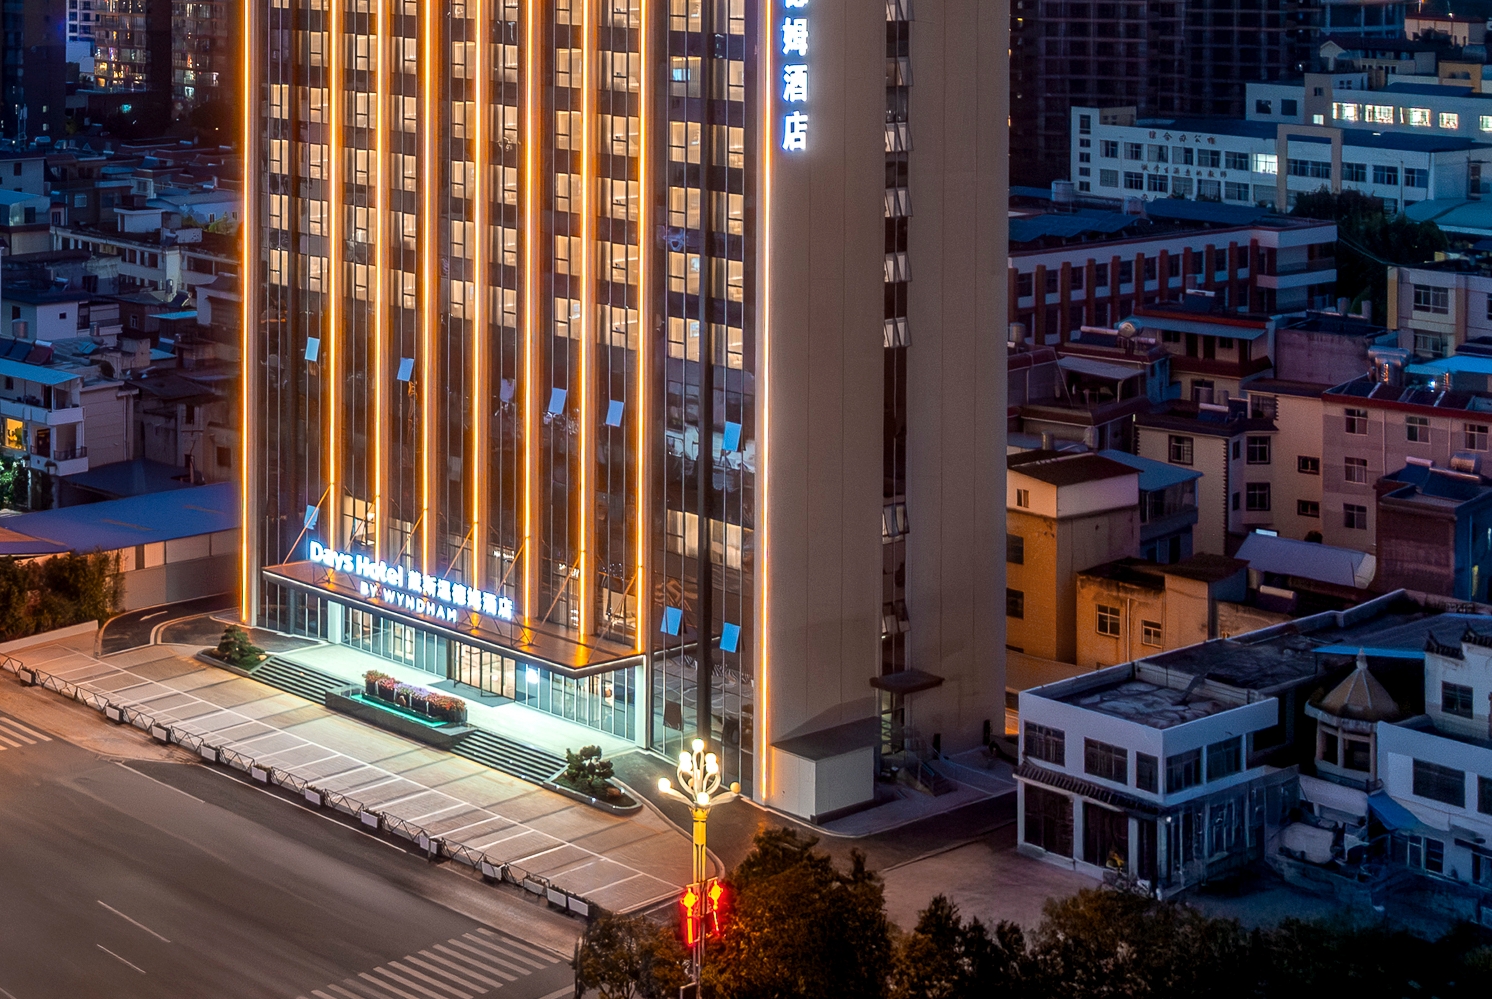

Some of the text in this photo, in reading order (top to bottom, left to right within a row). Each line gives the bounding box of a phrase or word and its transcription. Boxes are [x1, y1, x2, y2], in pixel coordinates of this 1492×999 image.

[309, 540, 404, 588] Days Hotel
[360, 581, 458, 623] BY WYNDHAM
